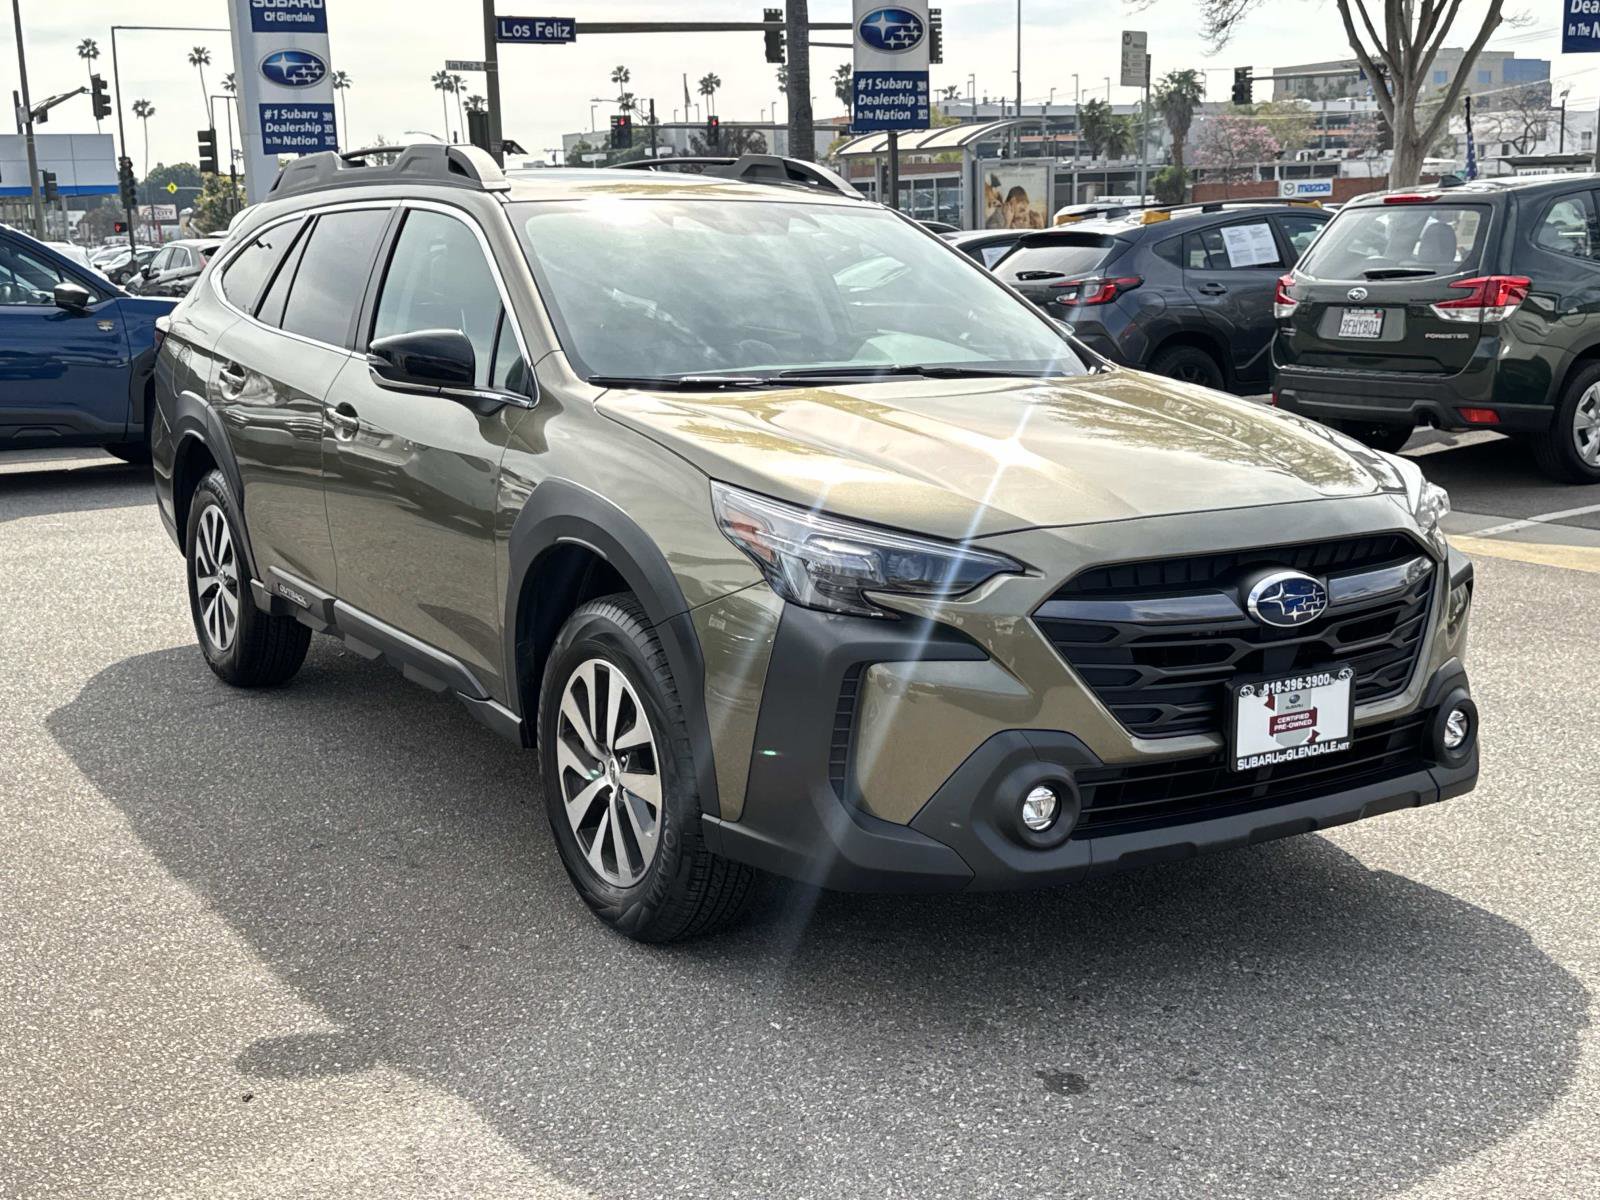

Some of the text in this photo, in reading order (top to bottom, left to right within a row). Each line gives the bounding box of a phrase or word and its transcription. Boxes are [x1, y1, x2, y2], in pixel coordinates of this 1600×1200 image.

[1570, 0, 1600, 14] Dea
[264, 11, 315, 22] Of Glendale
[501, 21, 570, 38] Los Feliz
[857, 78, 912, 90] #1 Subaru
[858, 93, 915, 107] Dealership
[264, 109, 318, 119] #1 Subaru
[874, 109, 911, 120] Nation
[265, 122, 322, 135] Dealership
[282, 135, 318, 146] Nation
[279, 584, 307, 605] OUTBACK
[1263, 673, 1330, 695] 818-396-3900
[1277, 712, 1310, 724] CERTIFIED
[1274, 719, 1313, 731] PRE-OWNED
